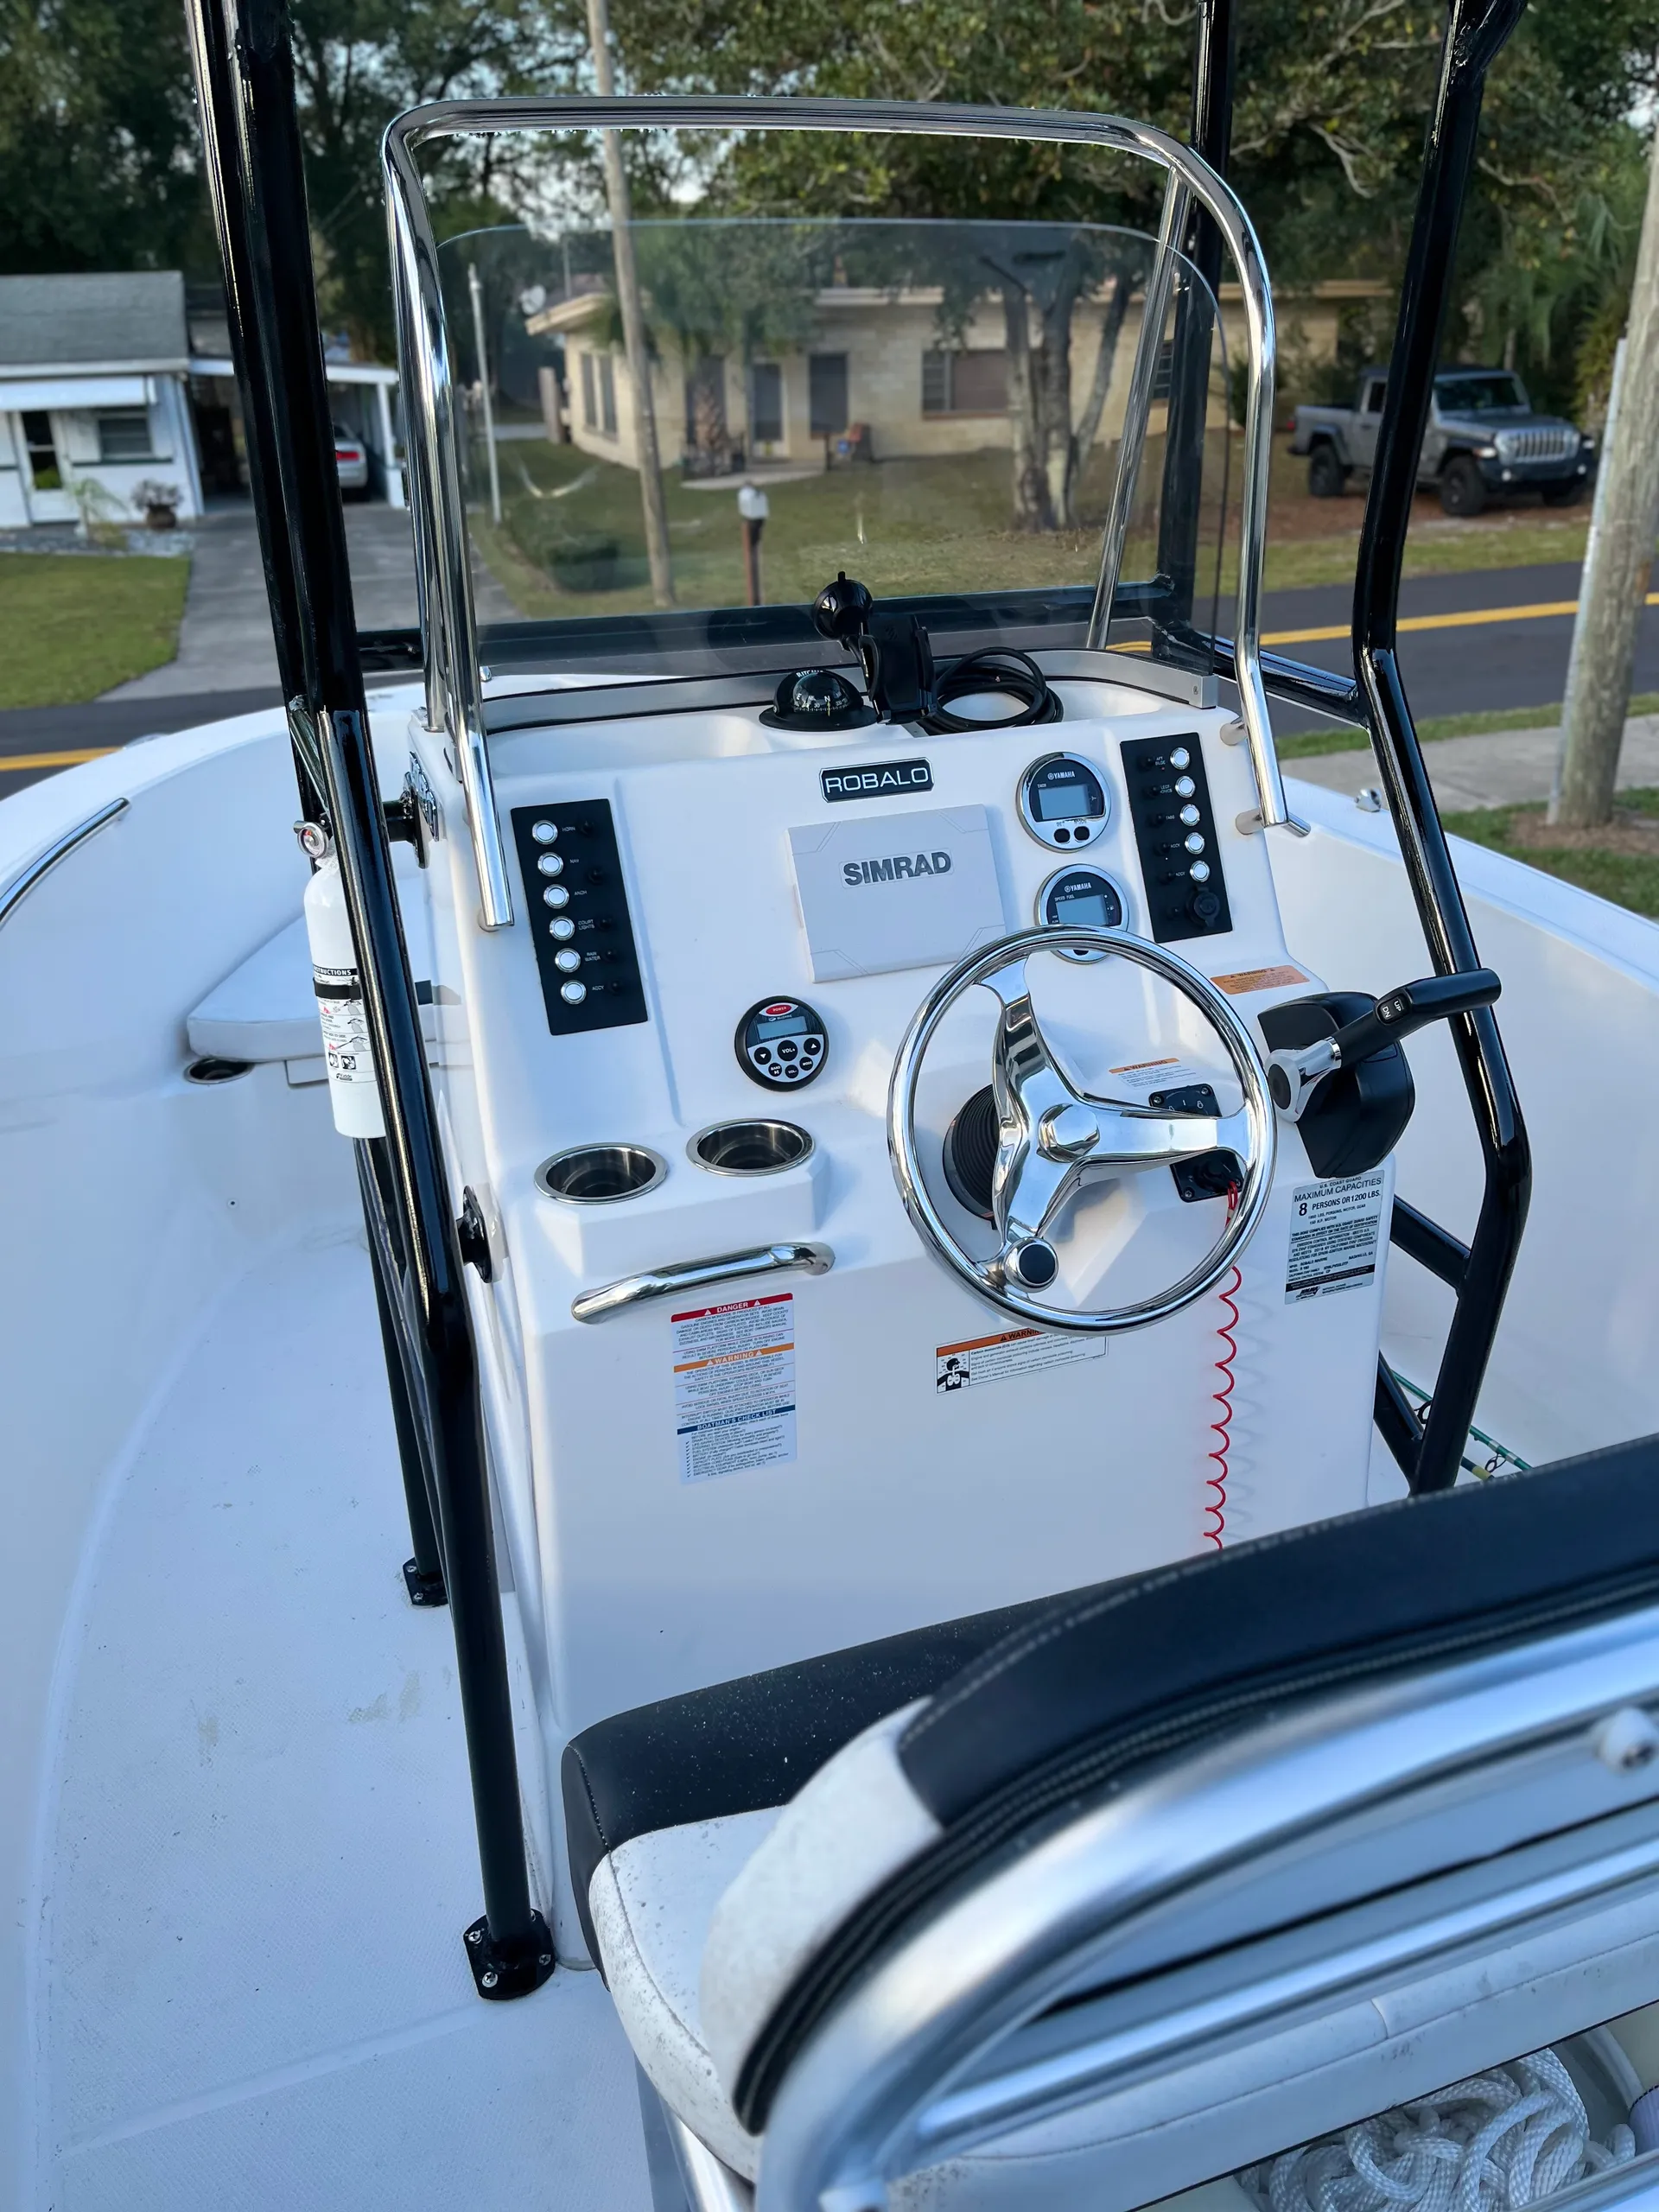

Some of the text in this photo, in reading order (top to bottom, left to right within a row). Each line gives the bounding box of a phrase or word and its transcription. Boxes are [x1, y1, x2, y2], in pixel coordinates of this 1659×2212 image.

[825, 767, 929, 793] ROBALO
[1054, 771, 1076, 779] YAMAHA
[843, 851, 951, 886] SIMRAD
[1071, 882, 1091, 892] YAMAHA
[1382, 1006, 1391, 1018] DN
[1394, 1001, 1402, 1012] UP
[1294, 1178, 1381, 1202] MAXIMUM CAPACITIES
[1299, 1203, 1307, 1216] 8
[1313, 1198, 1340, 1210] PERSONS
[717, 1302, 747, 1313] DANGER
[1008, 1330, 1039, 1339] WARNI
[715, 1352, 753, 1363] WARNING
[697, 1418, 735, 1430] BOATMAN'S
[738, 1413, 760, 1421] CHECK
